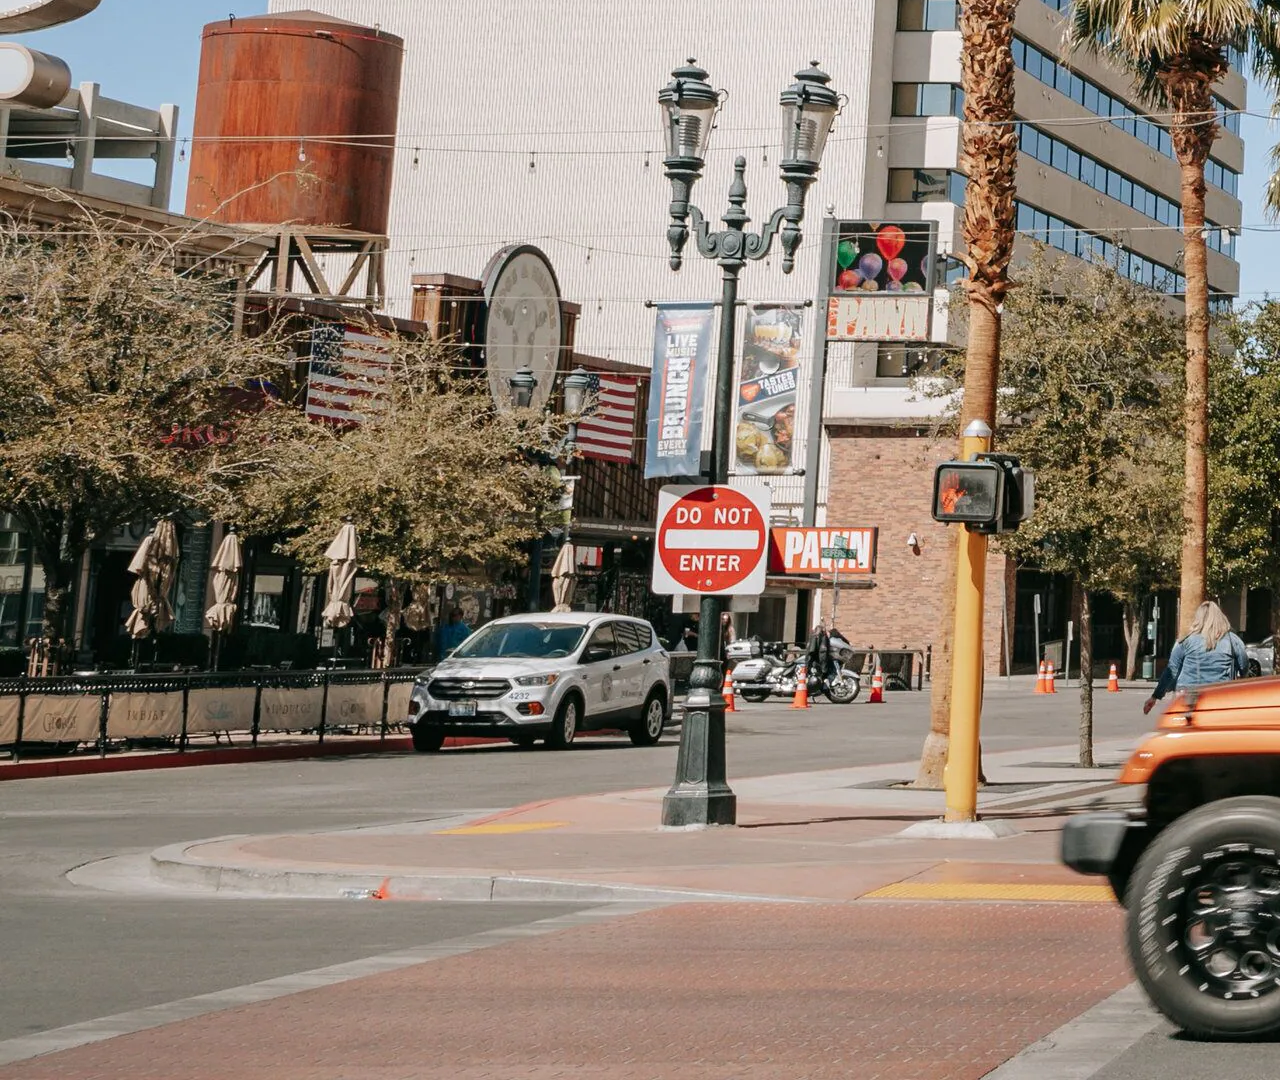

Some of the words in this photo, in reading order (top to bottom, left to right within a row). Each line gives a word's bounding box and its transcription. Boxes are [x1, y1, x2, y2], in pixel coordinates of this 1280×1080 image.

[838, 297, 928, 339] PAWN
[666, 334, 698, 348] LIVE
[665, 347, 697, 358] MUSIC
[662, 357, 691, 439] BRUNCH
[658, 439, 688, 451] EVERY
[676, 507, 702, 524] DO
[714, 508, 752, 525] NOT
[784, 531, 871, 569] PAWN
[679, 554, 741, 571] ENTER
[508, 692, 530, 700] 4232
